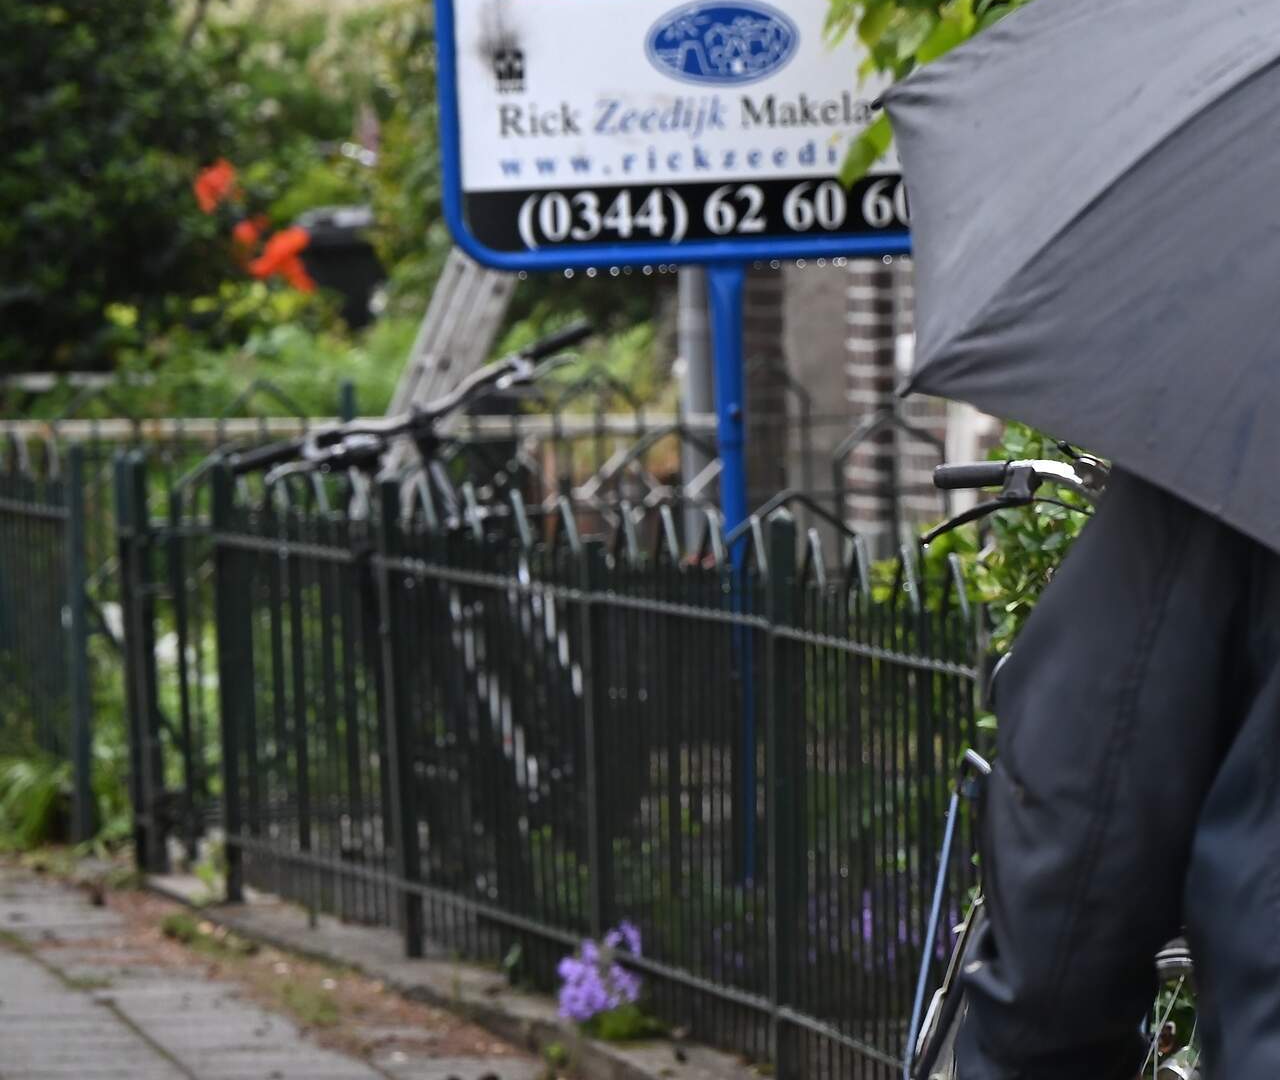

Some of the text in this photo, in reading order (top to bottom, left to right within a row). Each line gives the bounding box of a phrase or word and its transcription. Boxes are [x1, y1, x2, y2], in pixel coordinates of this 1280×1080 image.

[498, 101, 581, 139] Rick
[593, 94, 727, 141] Zeedijk
[517, 185, 690, 251] (0344)
[703, 182, 767, 235] 62
[782, 180, 847, 231] 60
